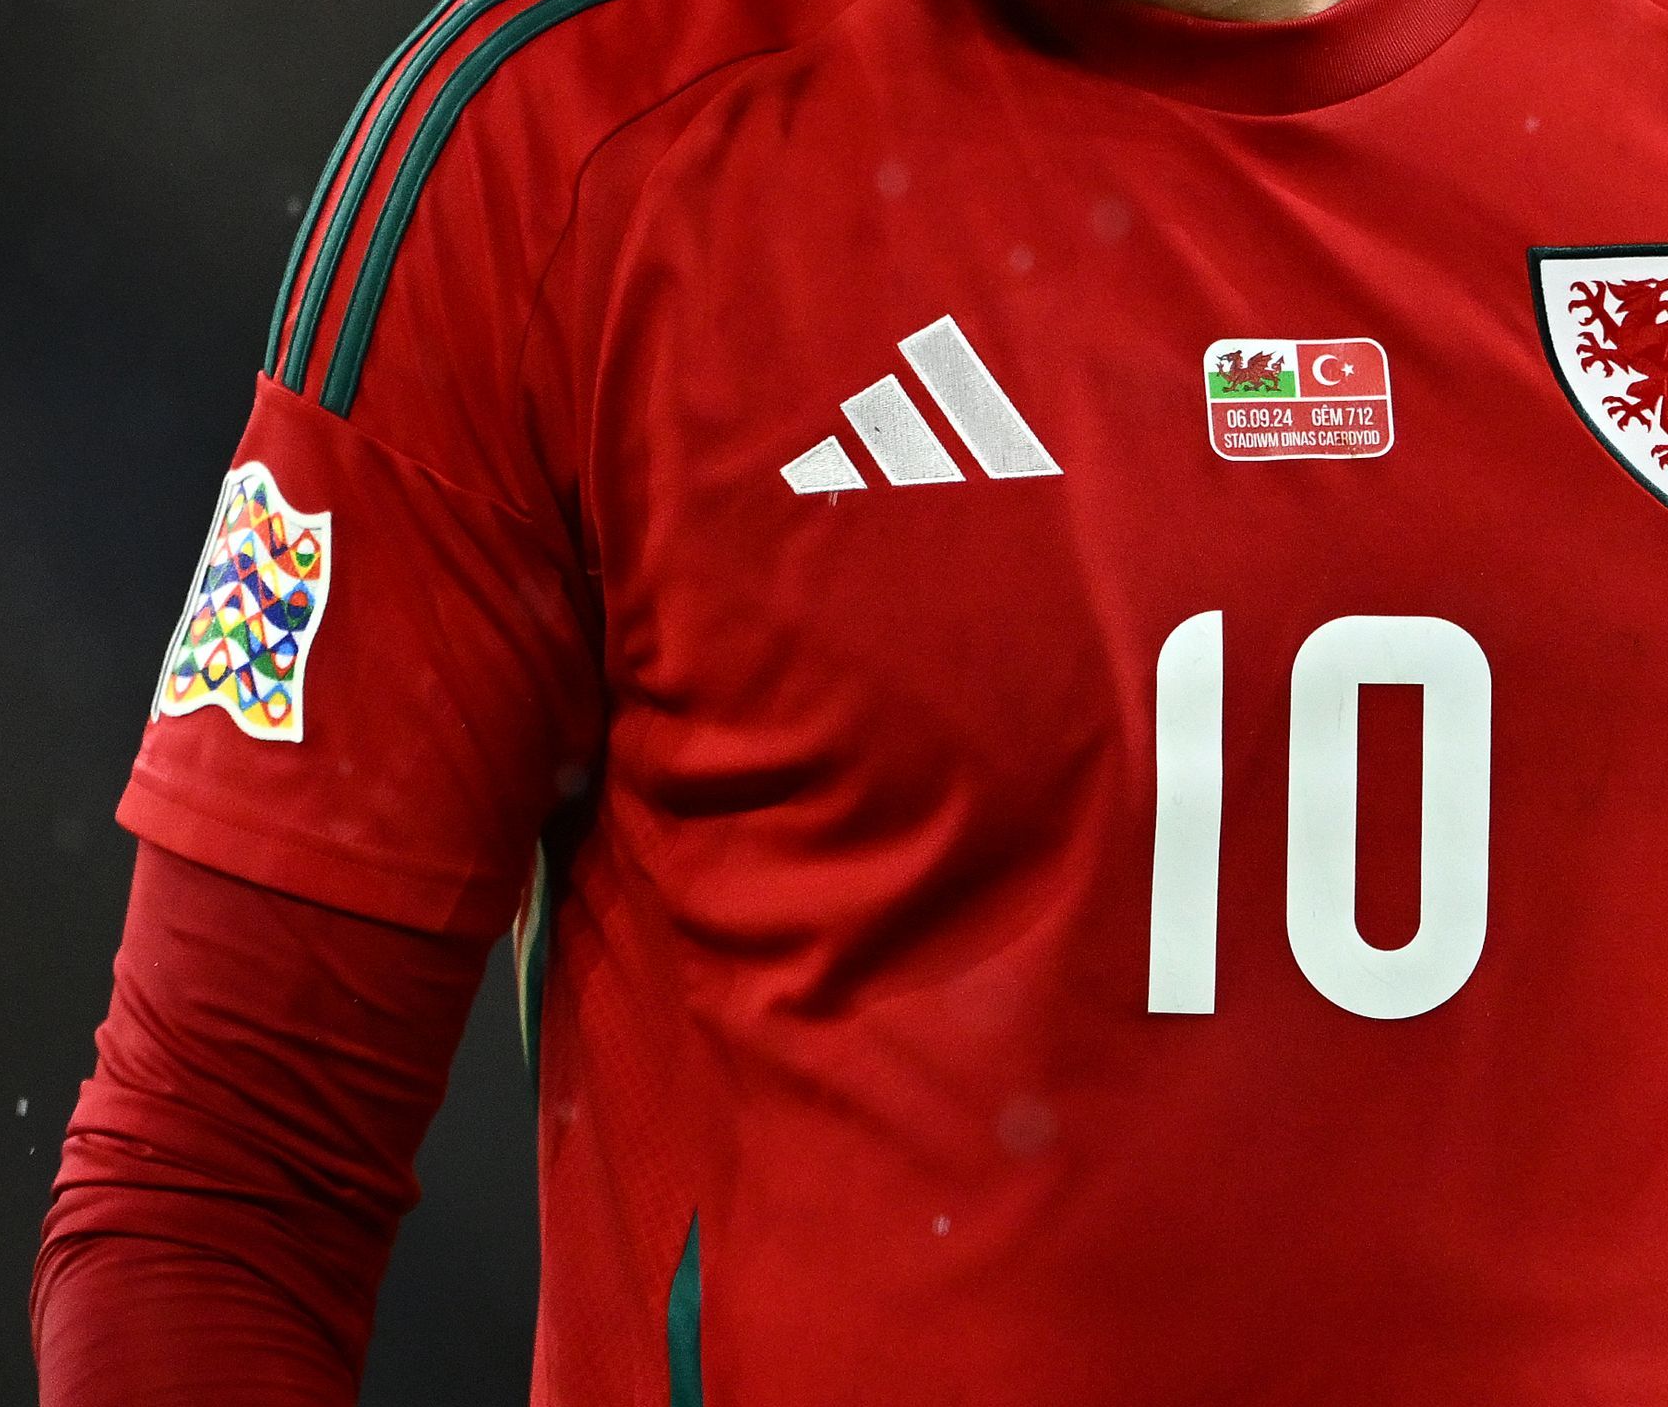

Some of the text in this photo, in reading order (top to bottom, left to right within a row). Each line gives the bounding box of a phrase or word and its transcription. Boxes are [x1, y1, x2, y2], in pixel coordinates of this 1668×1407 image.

[1226, 408, 1293, 428] 06.09.24
[1311, 404, 1374, 426] GÊM 712
[1224, 430, 1380, 448] STADIWM DINAS CAERDYDD
[1148, 610, 1492, 1019] 10
